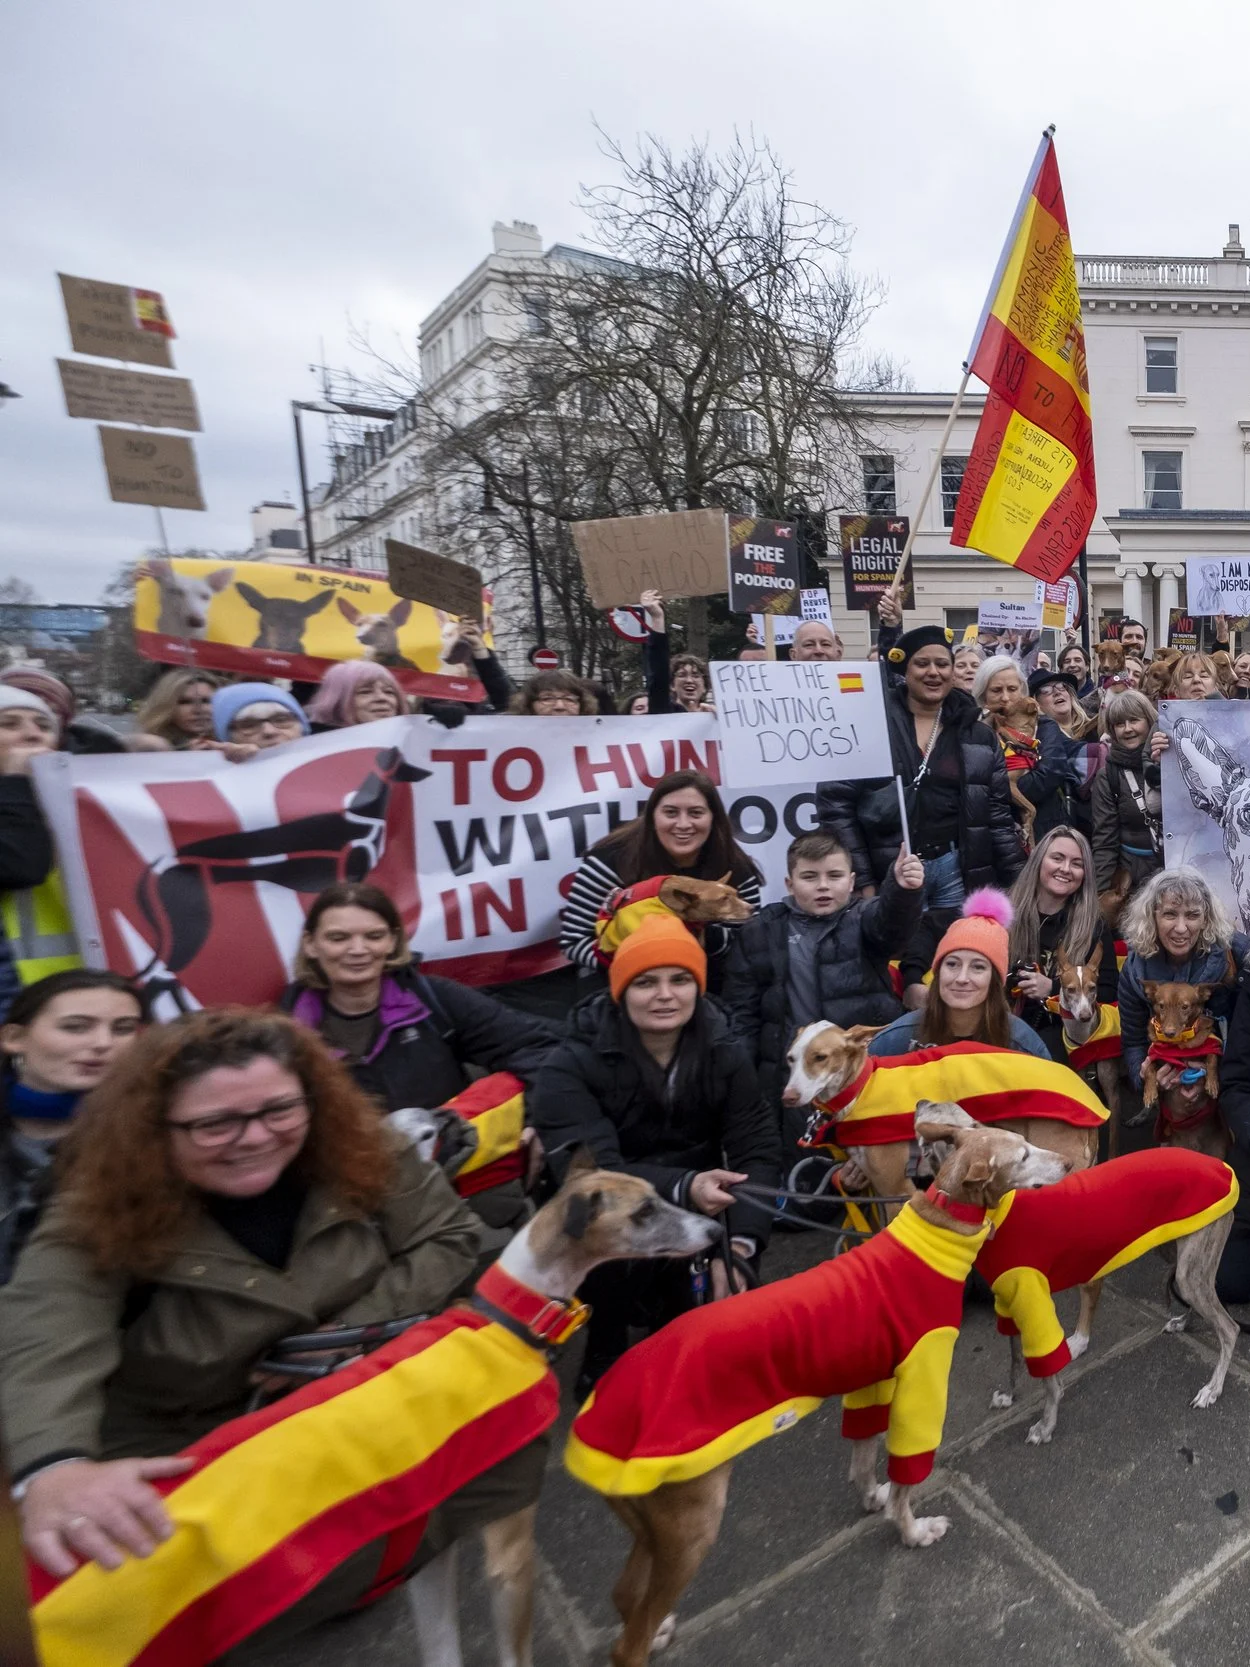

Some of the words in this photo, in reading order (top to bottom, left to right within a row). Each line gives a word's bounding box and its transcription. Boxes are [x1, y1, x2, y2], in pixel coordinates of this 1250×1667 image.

[1033, 381, 1055, 408] TO
[743, 543, 785, 564] FREE
[850, 537, 903, 554] LEGAL
[615, 549, 712, 594] GALGO
[754, 562, 776, 575] THE
[853, 573, 870, 581] FOR
[1221, 561, 1226, 578] I
[1228, 561, 1241, 578] AM
[319, 575, 372, 594] SPAIN
[734, 572, 796, 590] PODENCO
[799, 589, 818, 598] TOP
[999, 602, 1025, 611] Sultan
[1177, 617, 1194, 633] NO
[717, 663, 773, 693] FREE
[785, 663, 830, 690] THE
[722, 696, 837, 728] HUNTING
[756, 723, 862, 763] DOGS!
[431, 747, 545, 805] TO
[573, 739, 723, 793] HUN
[727, 792, 821, 845] OG
[440, 877, 528, 941] IN
